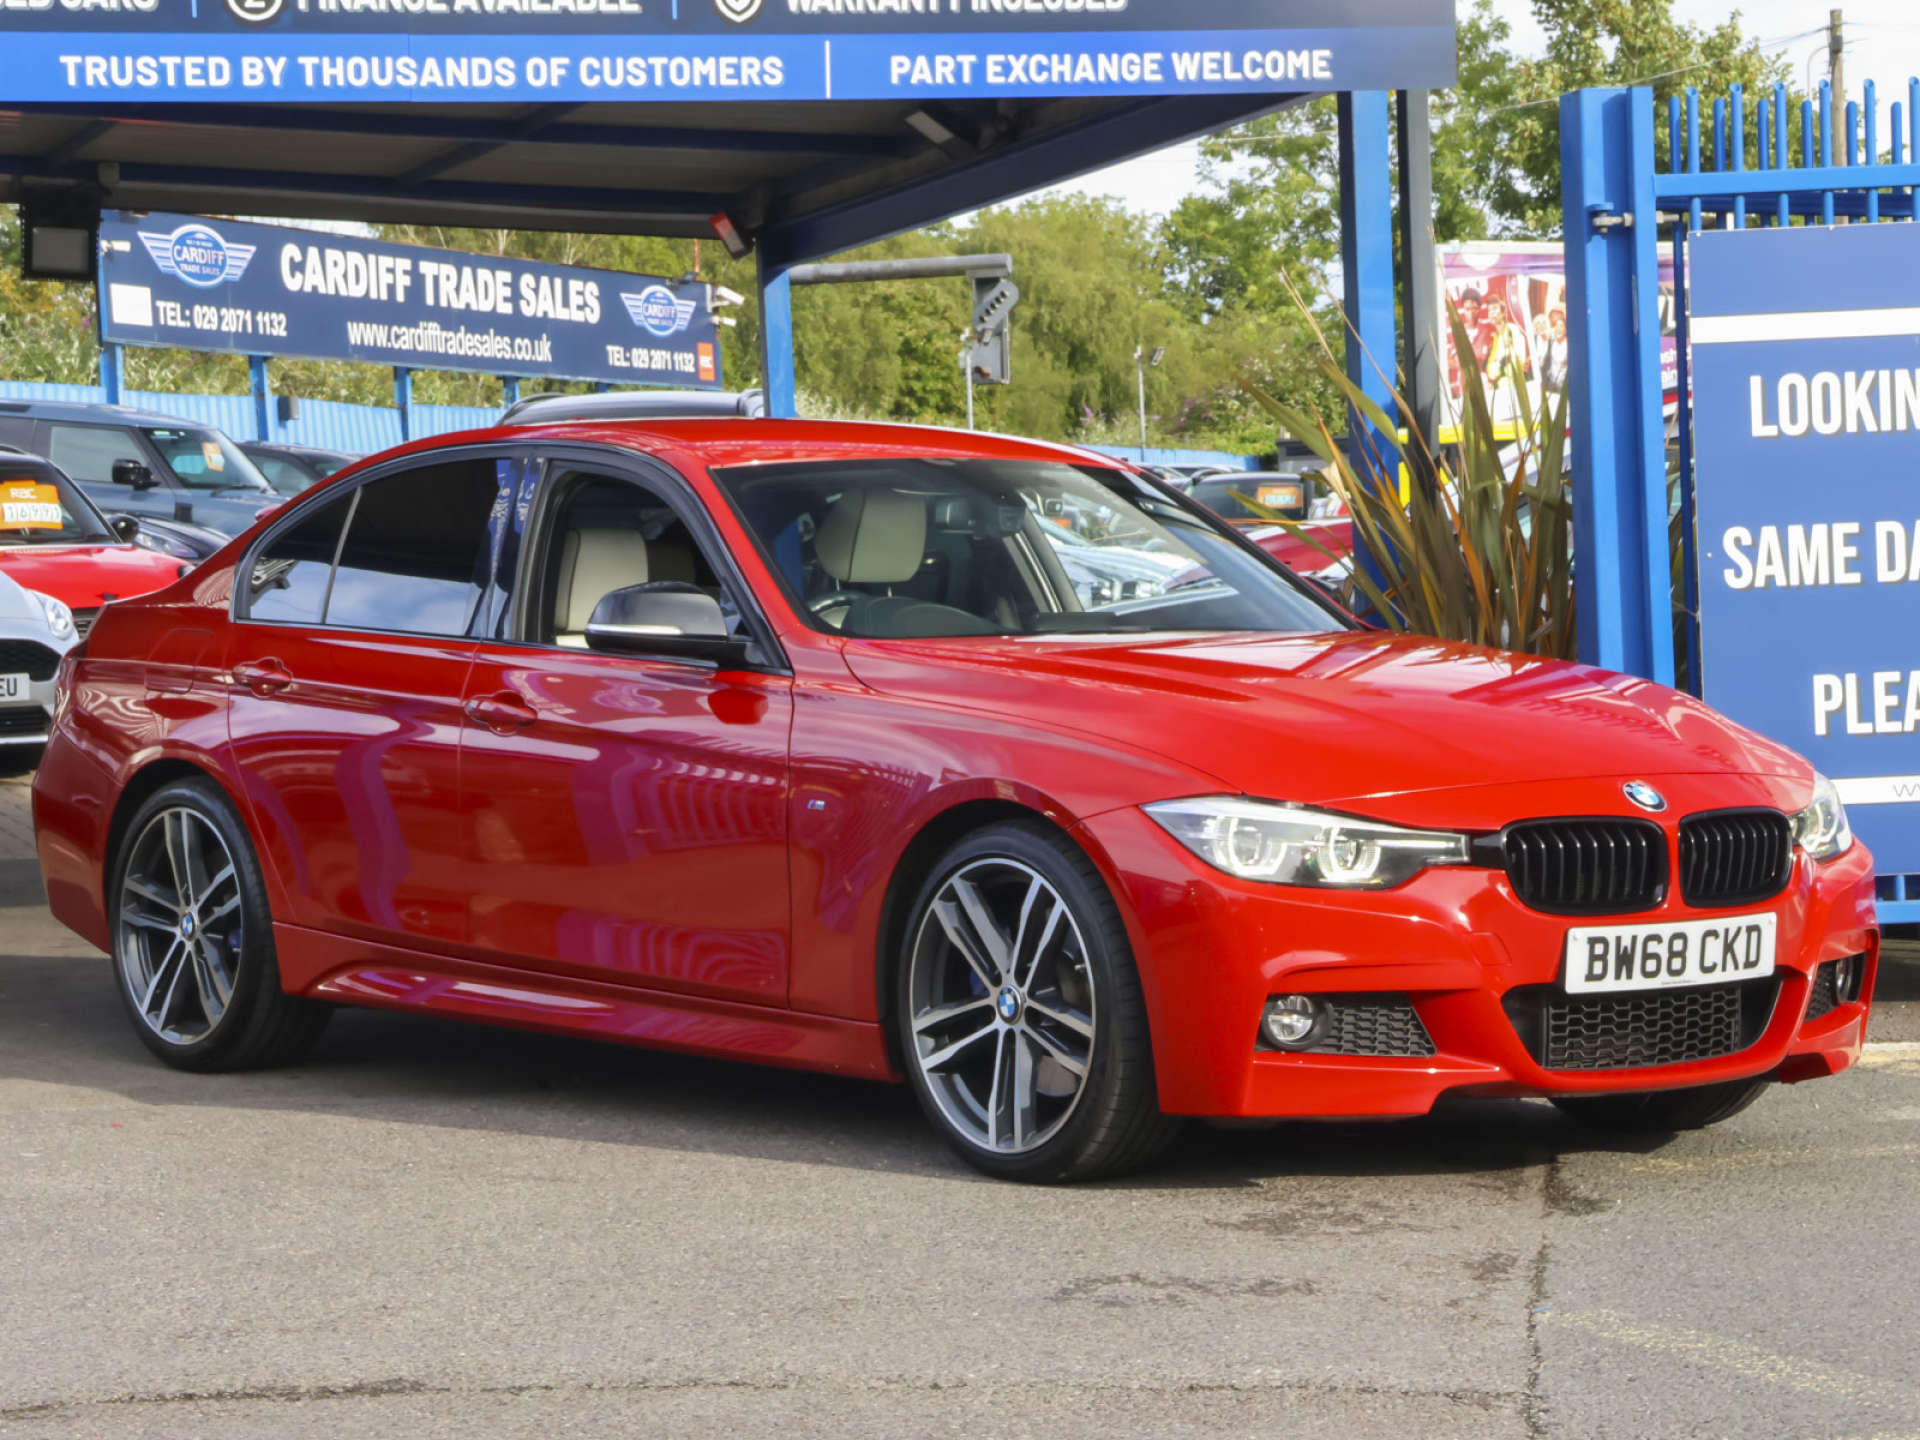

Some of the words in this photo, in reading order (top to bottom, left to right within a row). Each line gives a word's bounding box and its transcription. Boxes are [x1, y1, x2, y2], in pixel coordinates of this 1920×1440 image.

[59, 55, 231, 87] TRUSTED
[241, 56, 287, 87] BY
[298, 56, 517, 88] THOUSANDS
[526, 57, 570, 88] OF
[579, 56, 785, 88] CUSTOMERS
[890, 54, 978, 85] PART
[986, 52, 1164, 84] EXCHANGE
[1171, 49, 1334, 81] WELCOME
[173, 245, 225, 266] CARDIFF
[280, 242, 413, 303] CARDIFF
[419, 260, 514, 315] TRADE
[519, 272, 601, 325] SALES
[156, 300, 191, 328] TEL:
[193, 304, 218, 331] 029
[220, 307, 252, 334] 2071
[256, 311, 288, 337] 1132
[347, 320, 553, 363] www.cardifftradesales.co.uk
[606, 344, 631, 368] TEL:
[1722, 521, 1862, 590] SAME
[1584, 931, 1689, 983] BW68
[1698, 924, 1762, 975] CKD
